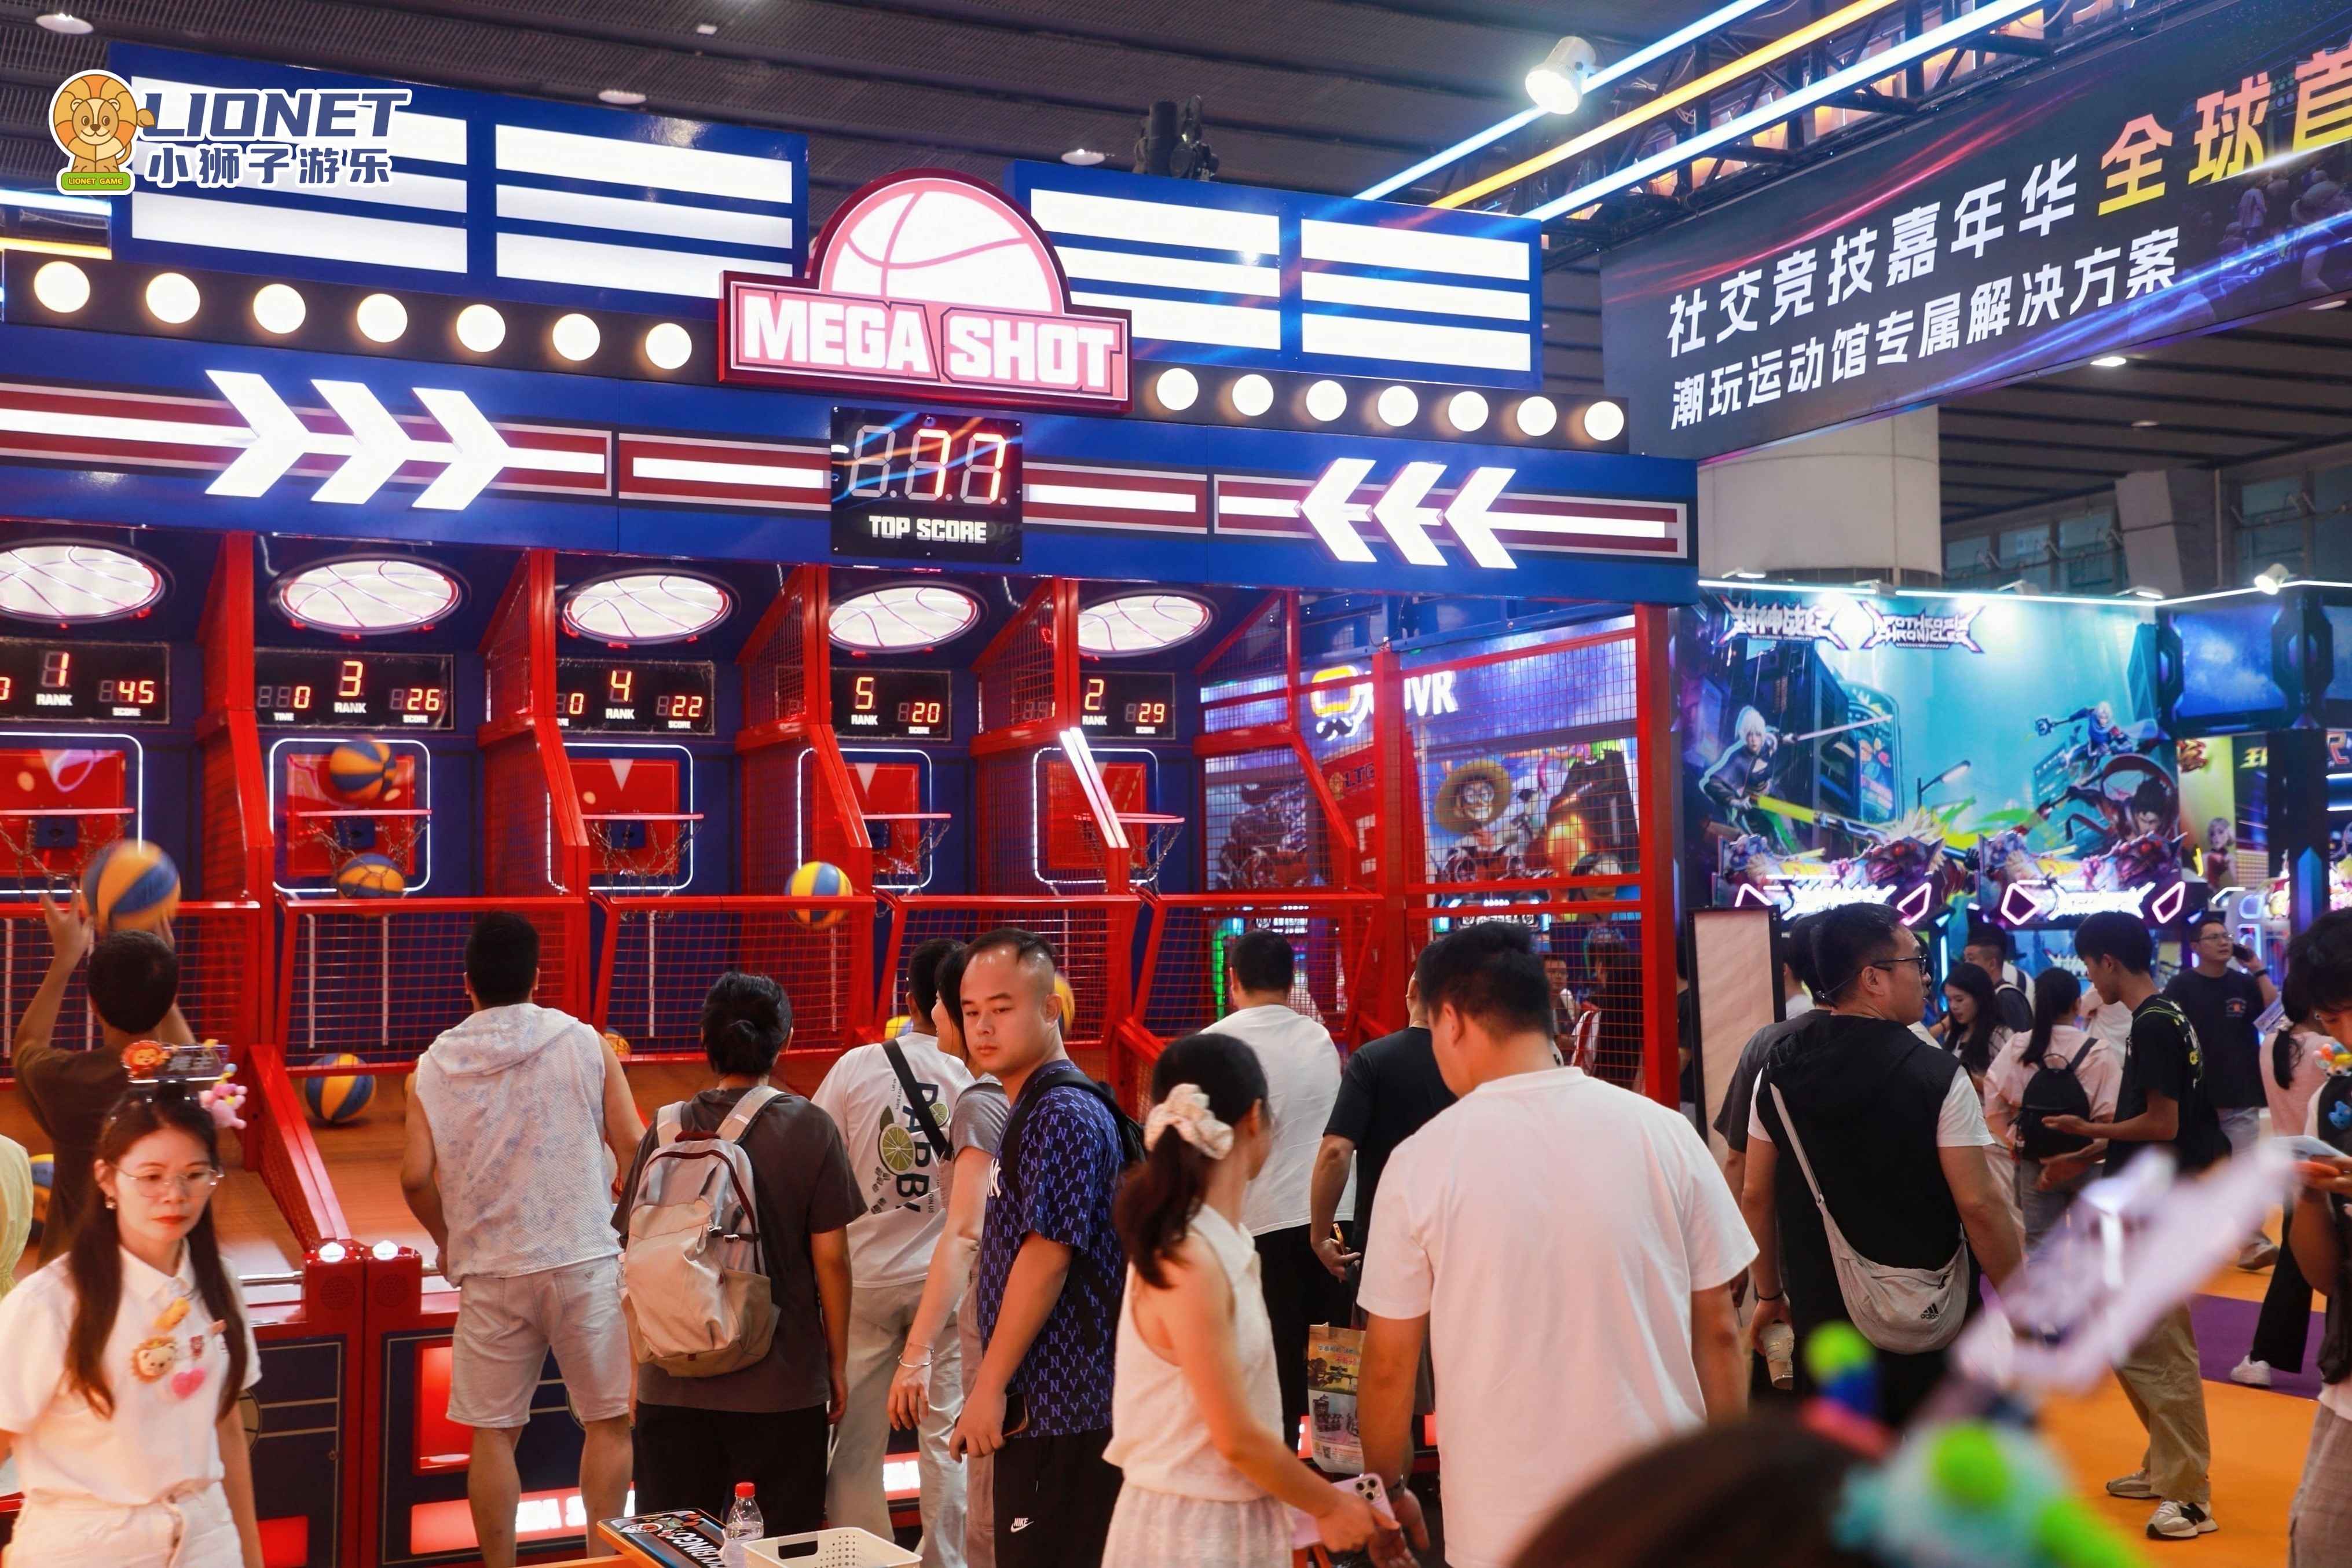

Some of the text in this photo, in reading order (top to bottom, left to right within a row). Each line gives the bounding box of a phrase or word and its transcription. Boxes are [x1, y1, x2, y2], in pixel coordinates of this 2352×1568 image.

[1670, 226, 2179, 431] 潮玩运动馆专属解决方案
[743, 294, 1115, 388] MEGA SHOT
[917, 428, 1006, 503] 77
[869, 515, 987, 544] TOP SCORE
[58, 652, 69, 687] 1
[338, 661, 364, 697] 3
[119, 680, 155, 704] 45
[610, 670, 632, 702] 4
[855, 676, 874, 710] 5
[1084, 679, 1105, 711] 2
[36, 694, 73, 706] RANK
[294, 686, 311, 709] 0
[334, 702, 367, 714] RANK
[406, 688, 440, 711] 26
[569, 693, 584, 715] 0
[672, 695, 703, 717] 22
[402, 714, 428, 724] SCORE
[605, 708, 635, 720] RANK
[851, 715, 878, 726] RANK
[911, 702, 941, 723] 20
[1082, 715, 1108, 726] RANK
[1138, 702, 1166, 723] 29
[668, 720, 691, 729] SCORE
[1013, 1517, 1029, 1527] NIKE
